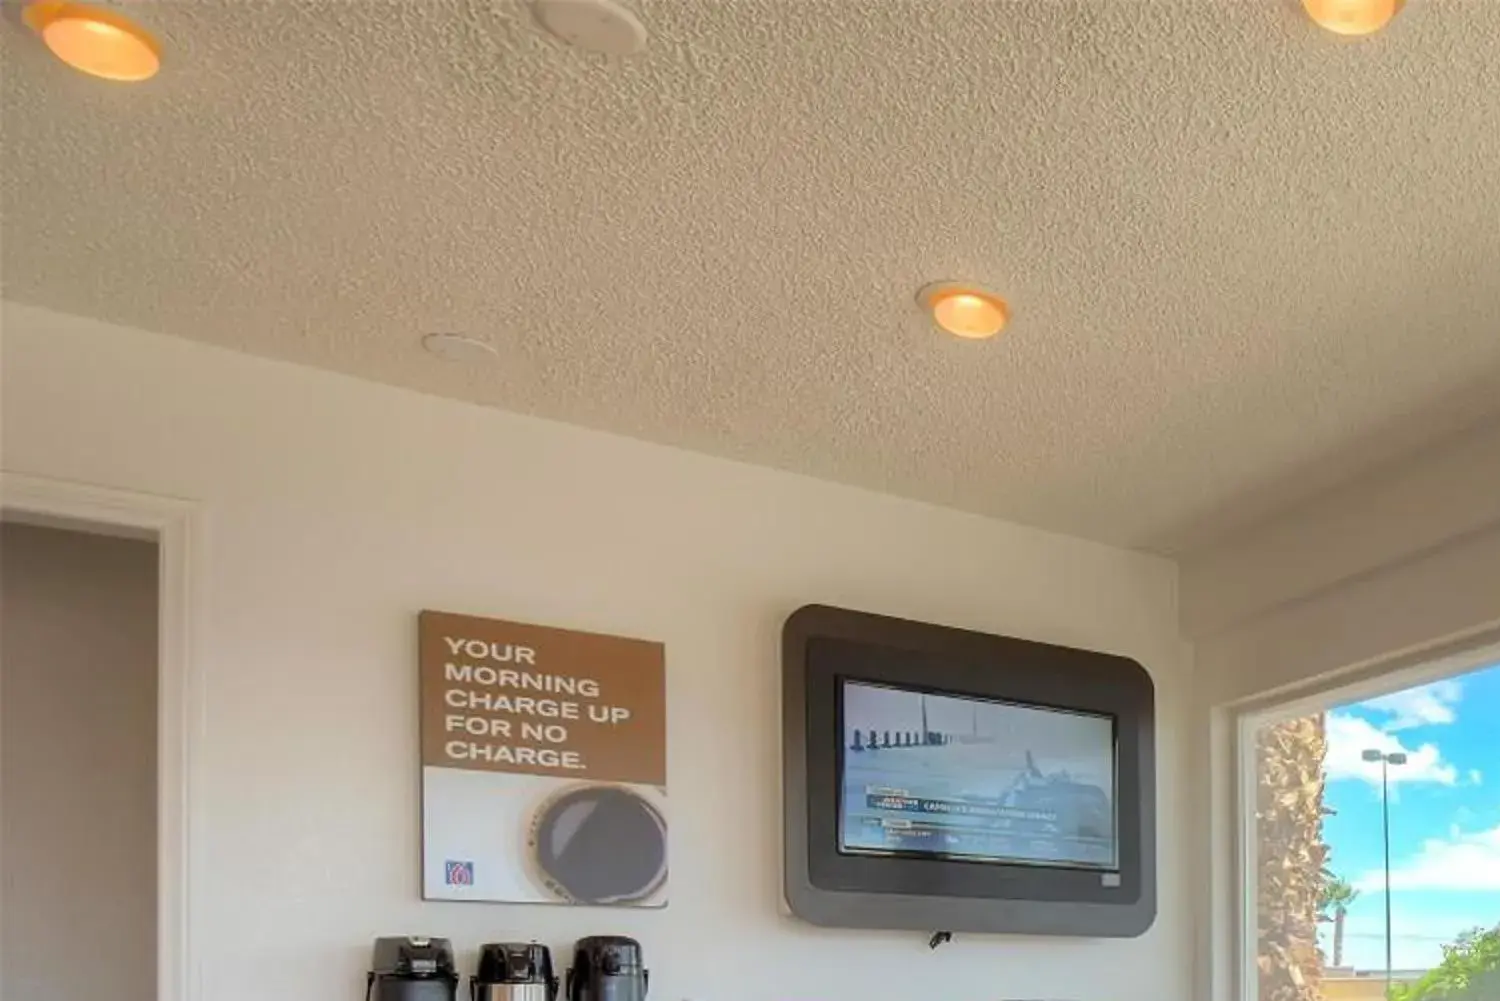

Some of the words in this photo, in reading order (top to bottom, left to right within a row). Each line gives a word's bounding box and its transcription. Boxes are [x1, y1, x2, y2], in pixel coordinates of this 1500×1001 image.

[443, 636, 536, 665] YOUR
[444, 663, 600, 697] MORNING
[444, 689, 580, 720] CHARGE
[588, 705, 631, 724] UP
[444, 714, 512, 737] FOR
[521, 722, 568, 743] NO
[444, 741, 587, 769] CHARGE.
